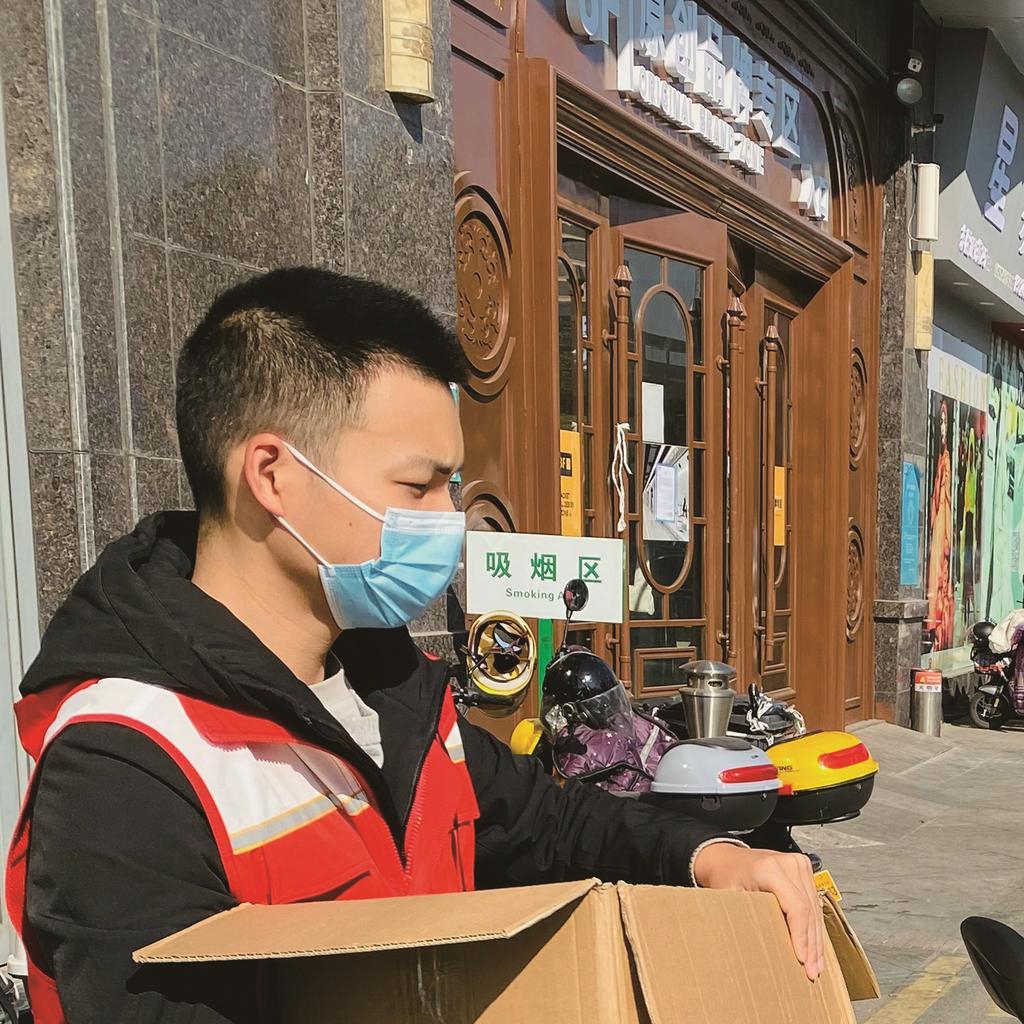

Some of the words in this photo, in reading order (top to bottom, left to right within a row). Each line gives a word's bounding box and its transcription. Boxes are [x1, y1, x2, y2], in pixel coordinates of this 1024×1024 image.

[486, 551, 602, 584] 吸烟区
[505, 587, 555, 602] Smoking
